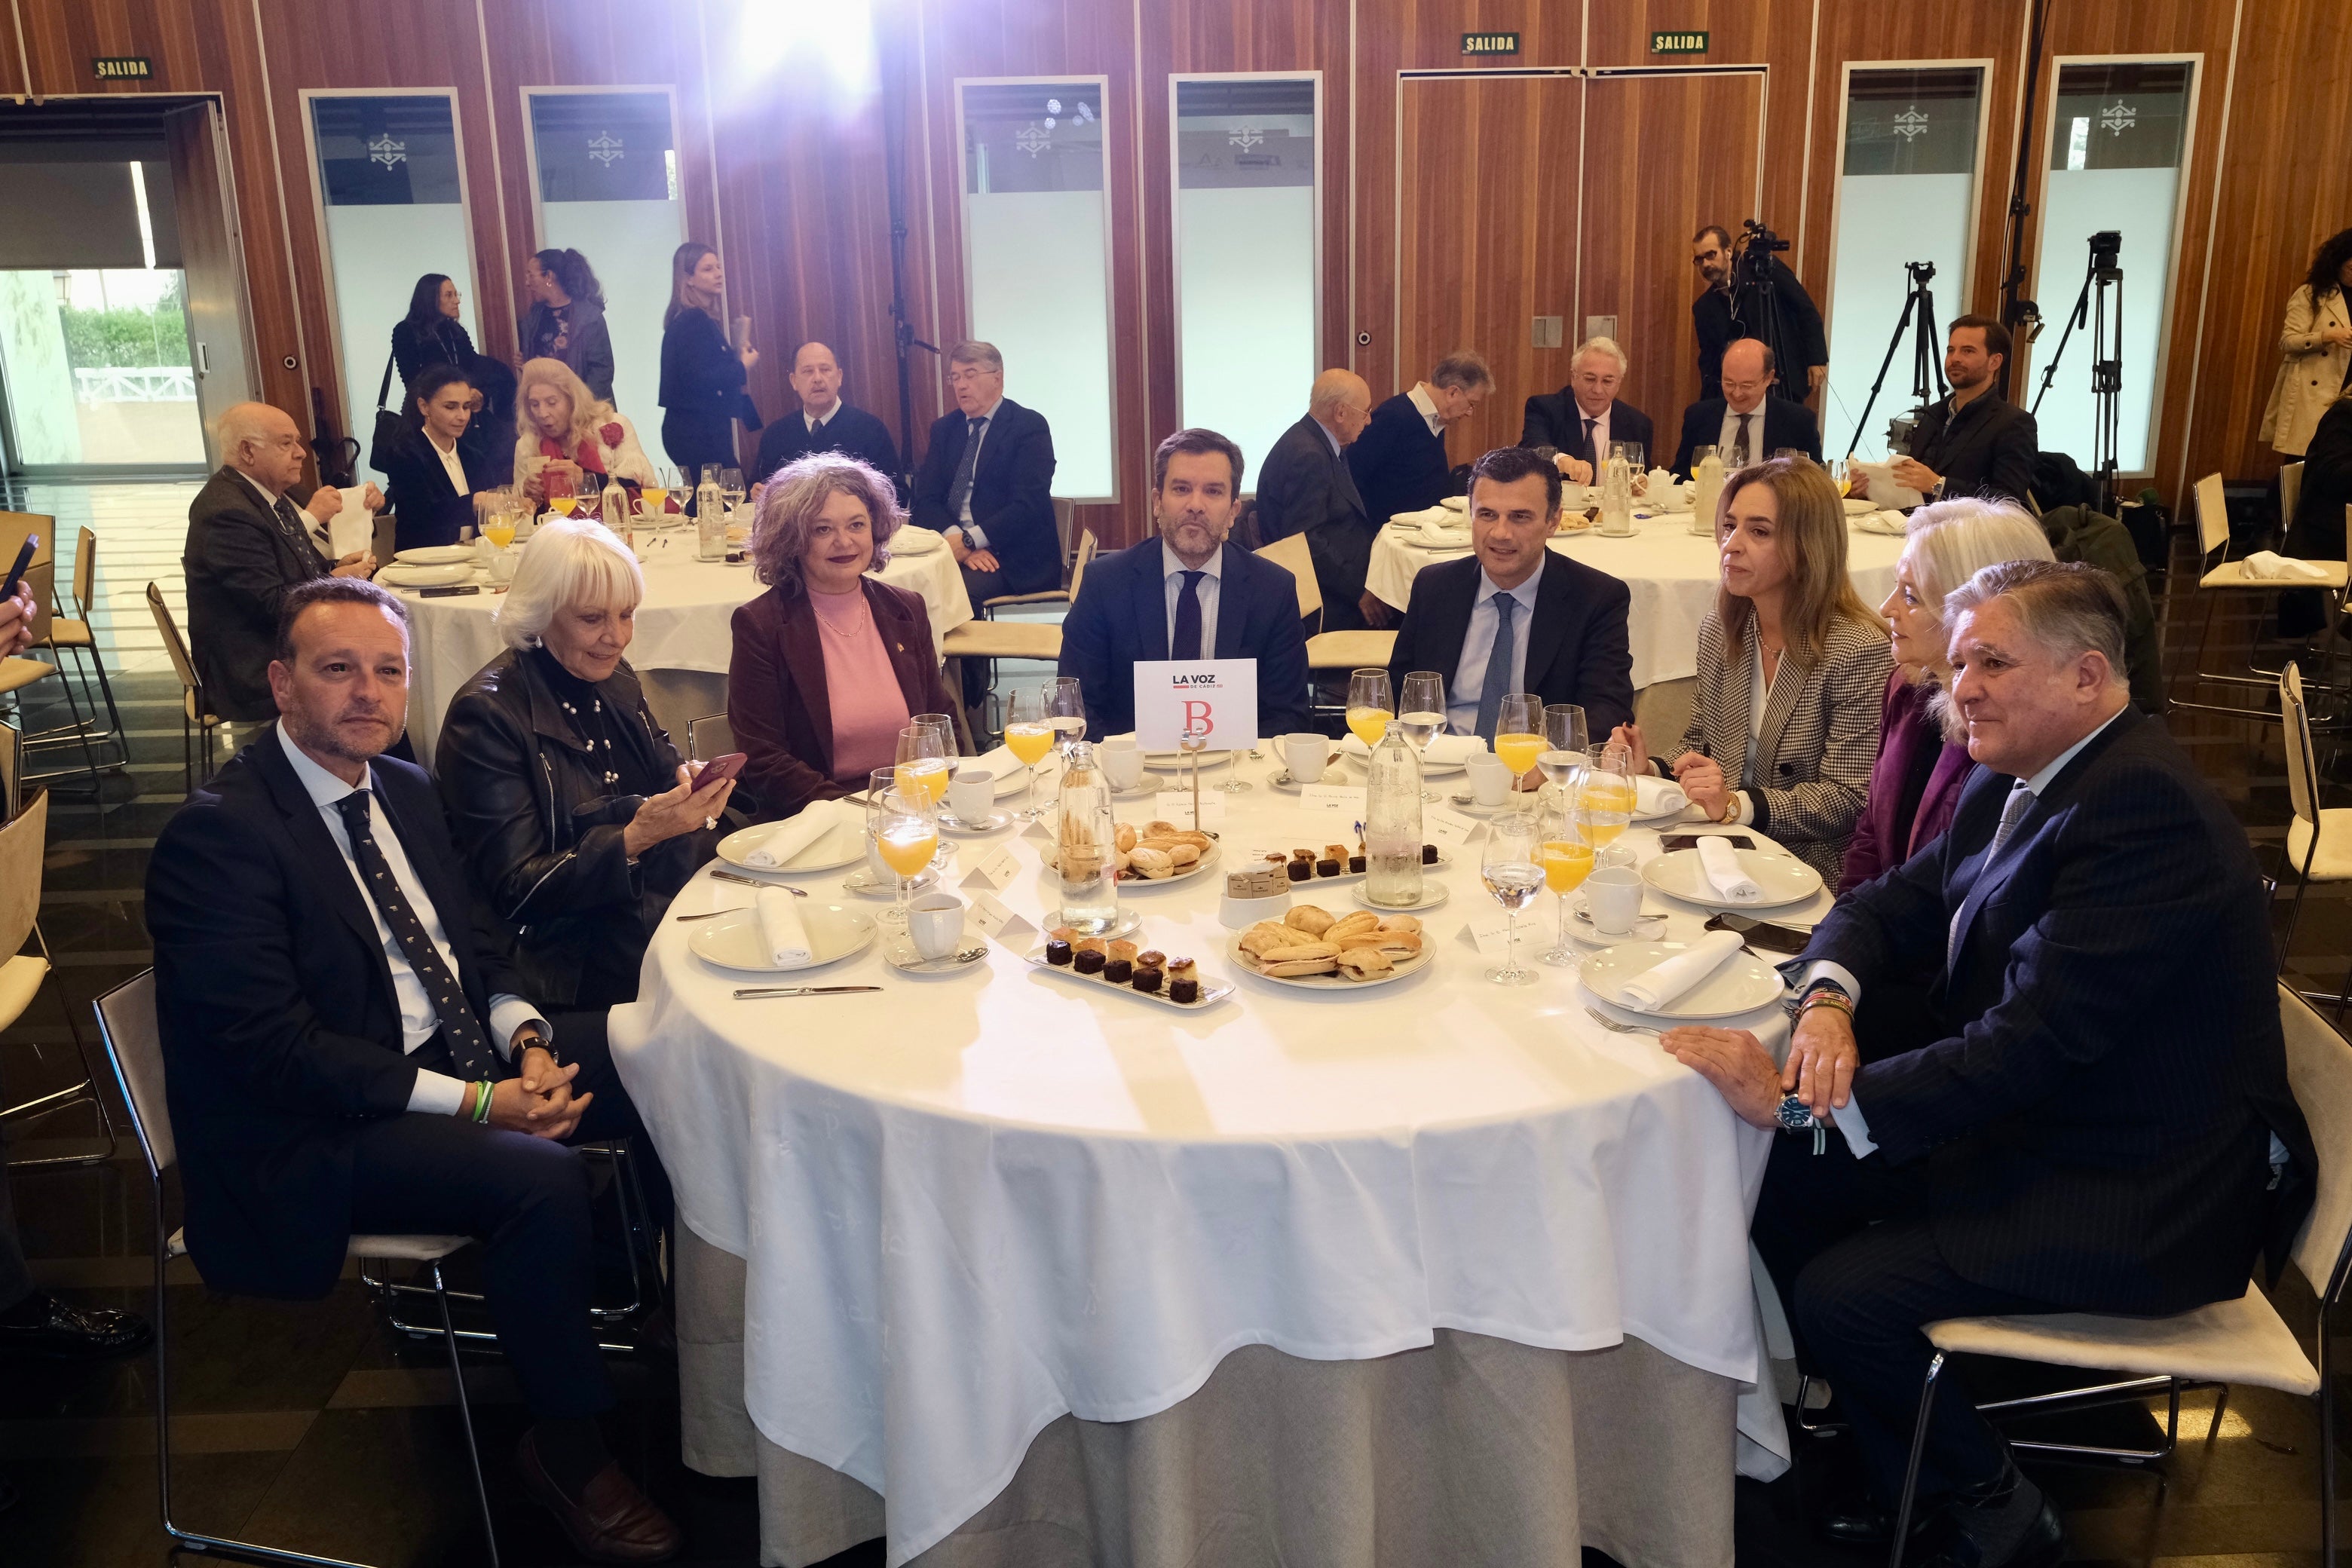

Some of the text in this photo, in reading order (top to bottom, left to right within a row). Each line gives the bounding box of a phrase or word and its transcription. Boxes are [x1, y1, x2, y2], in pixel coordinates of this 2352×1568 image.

[1466, 36, 1514, 51] SALIDA
[1656, 35, 1704, 49] SALIDA
[97, 62, 148, 75] SALIDA
[1173, 675, 1215, 684] LA VOZ
[1181, 700, 1214, 737] B
